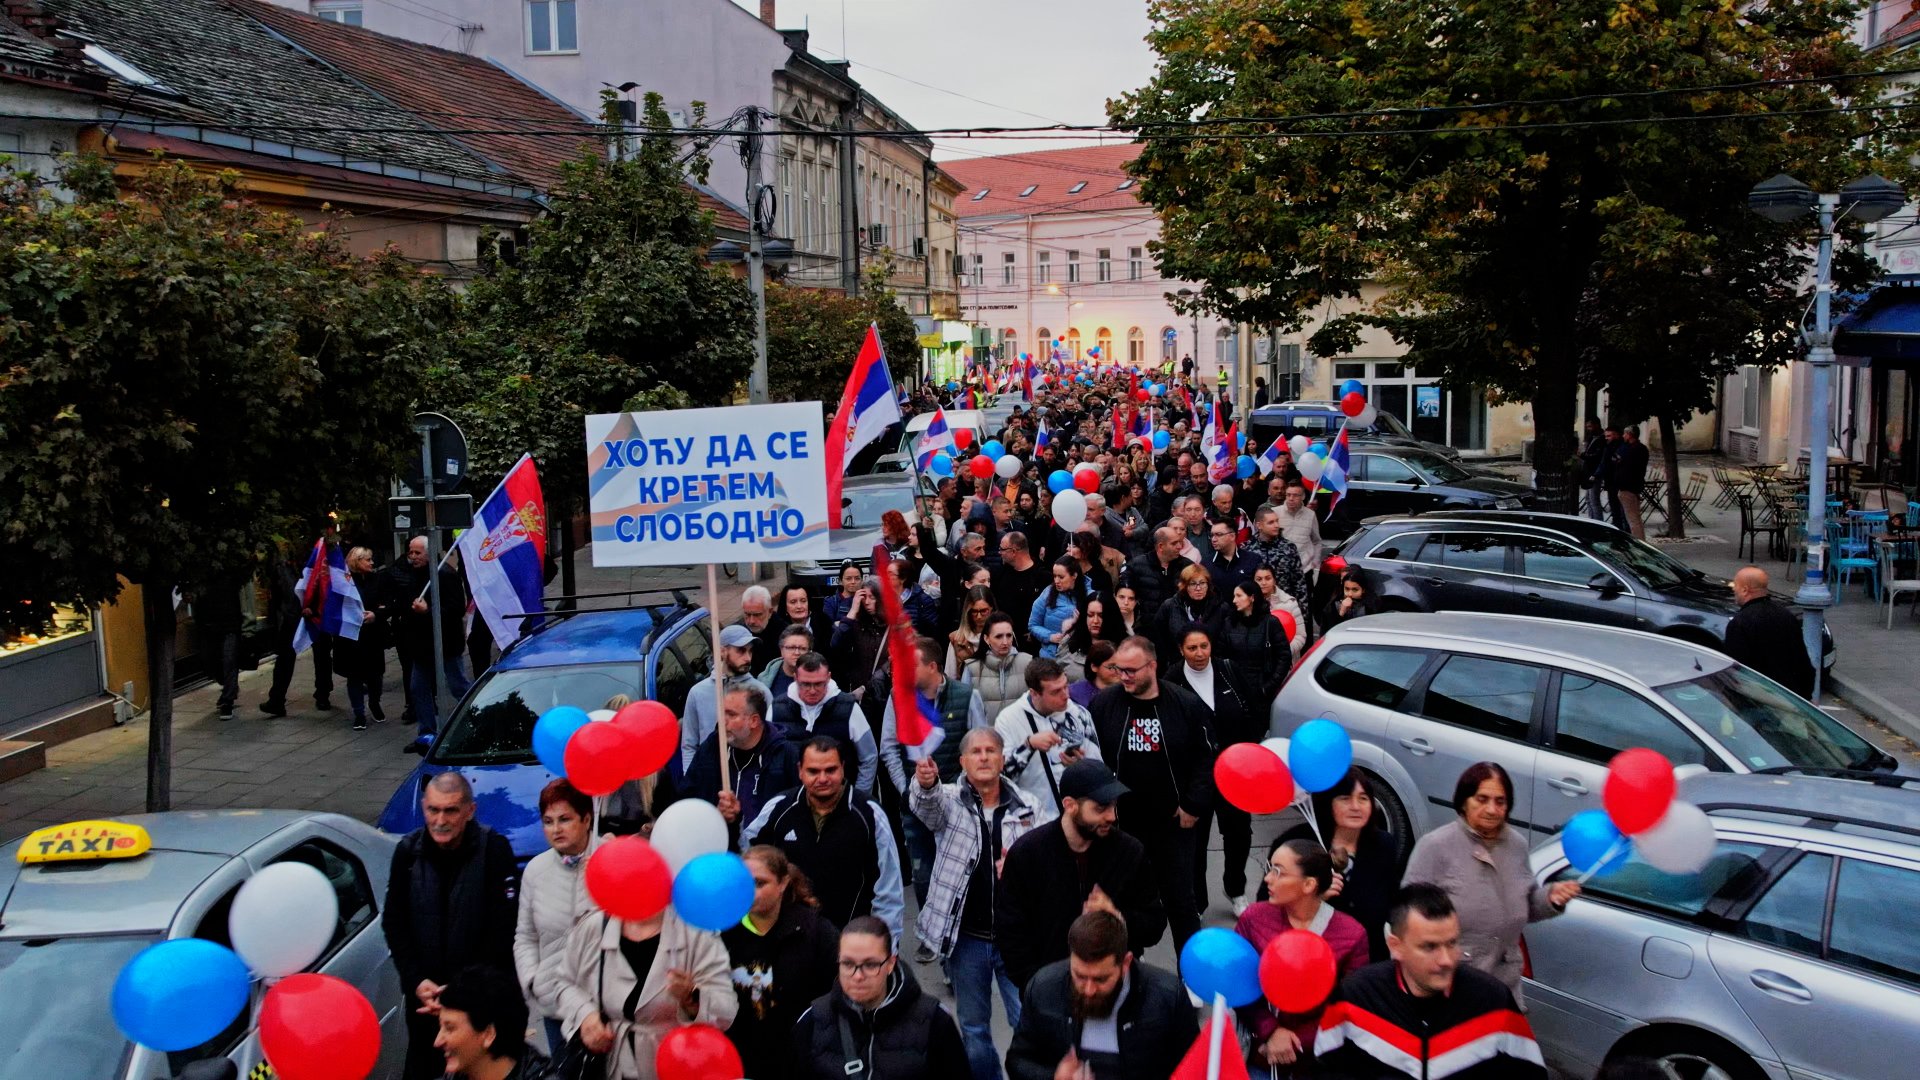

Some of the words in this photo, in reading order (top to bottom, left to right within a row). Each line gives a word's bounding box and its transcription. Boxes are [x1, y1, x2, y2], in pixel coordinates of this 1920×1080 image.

[604, 436, 695, 469] ХОЋУ
[706, 434, 756, 469] ДА
[766, 431, 809, 461] СЕ
[639, 471, 775, 505] КРЕЋЕМ
[615, 508, 805, 544] СЛОБОДНО
[1128, 734, 1160, 743] HUGO
[1128, 742, 1160, 752] HUGO
[55, 828, 108, 840] ALFA
[39, 837, 115, 855] TAXI
